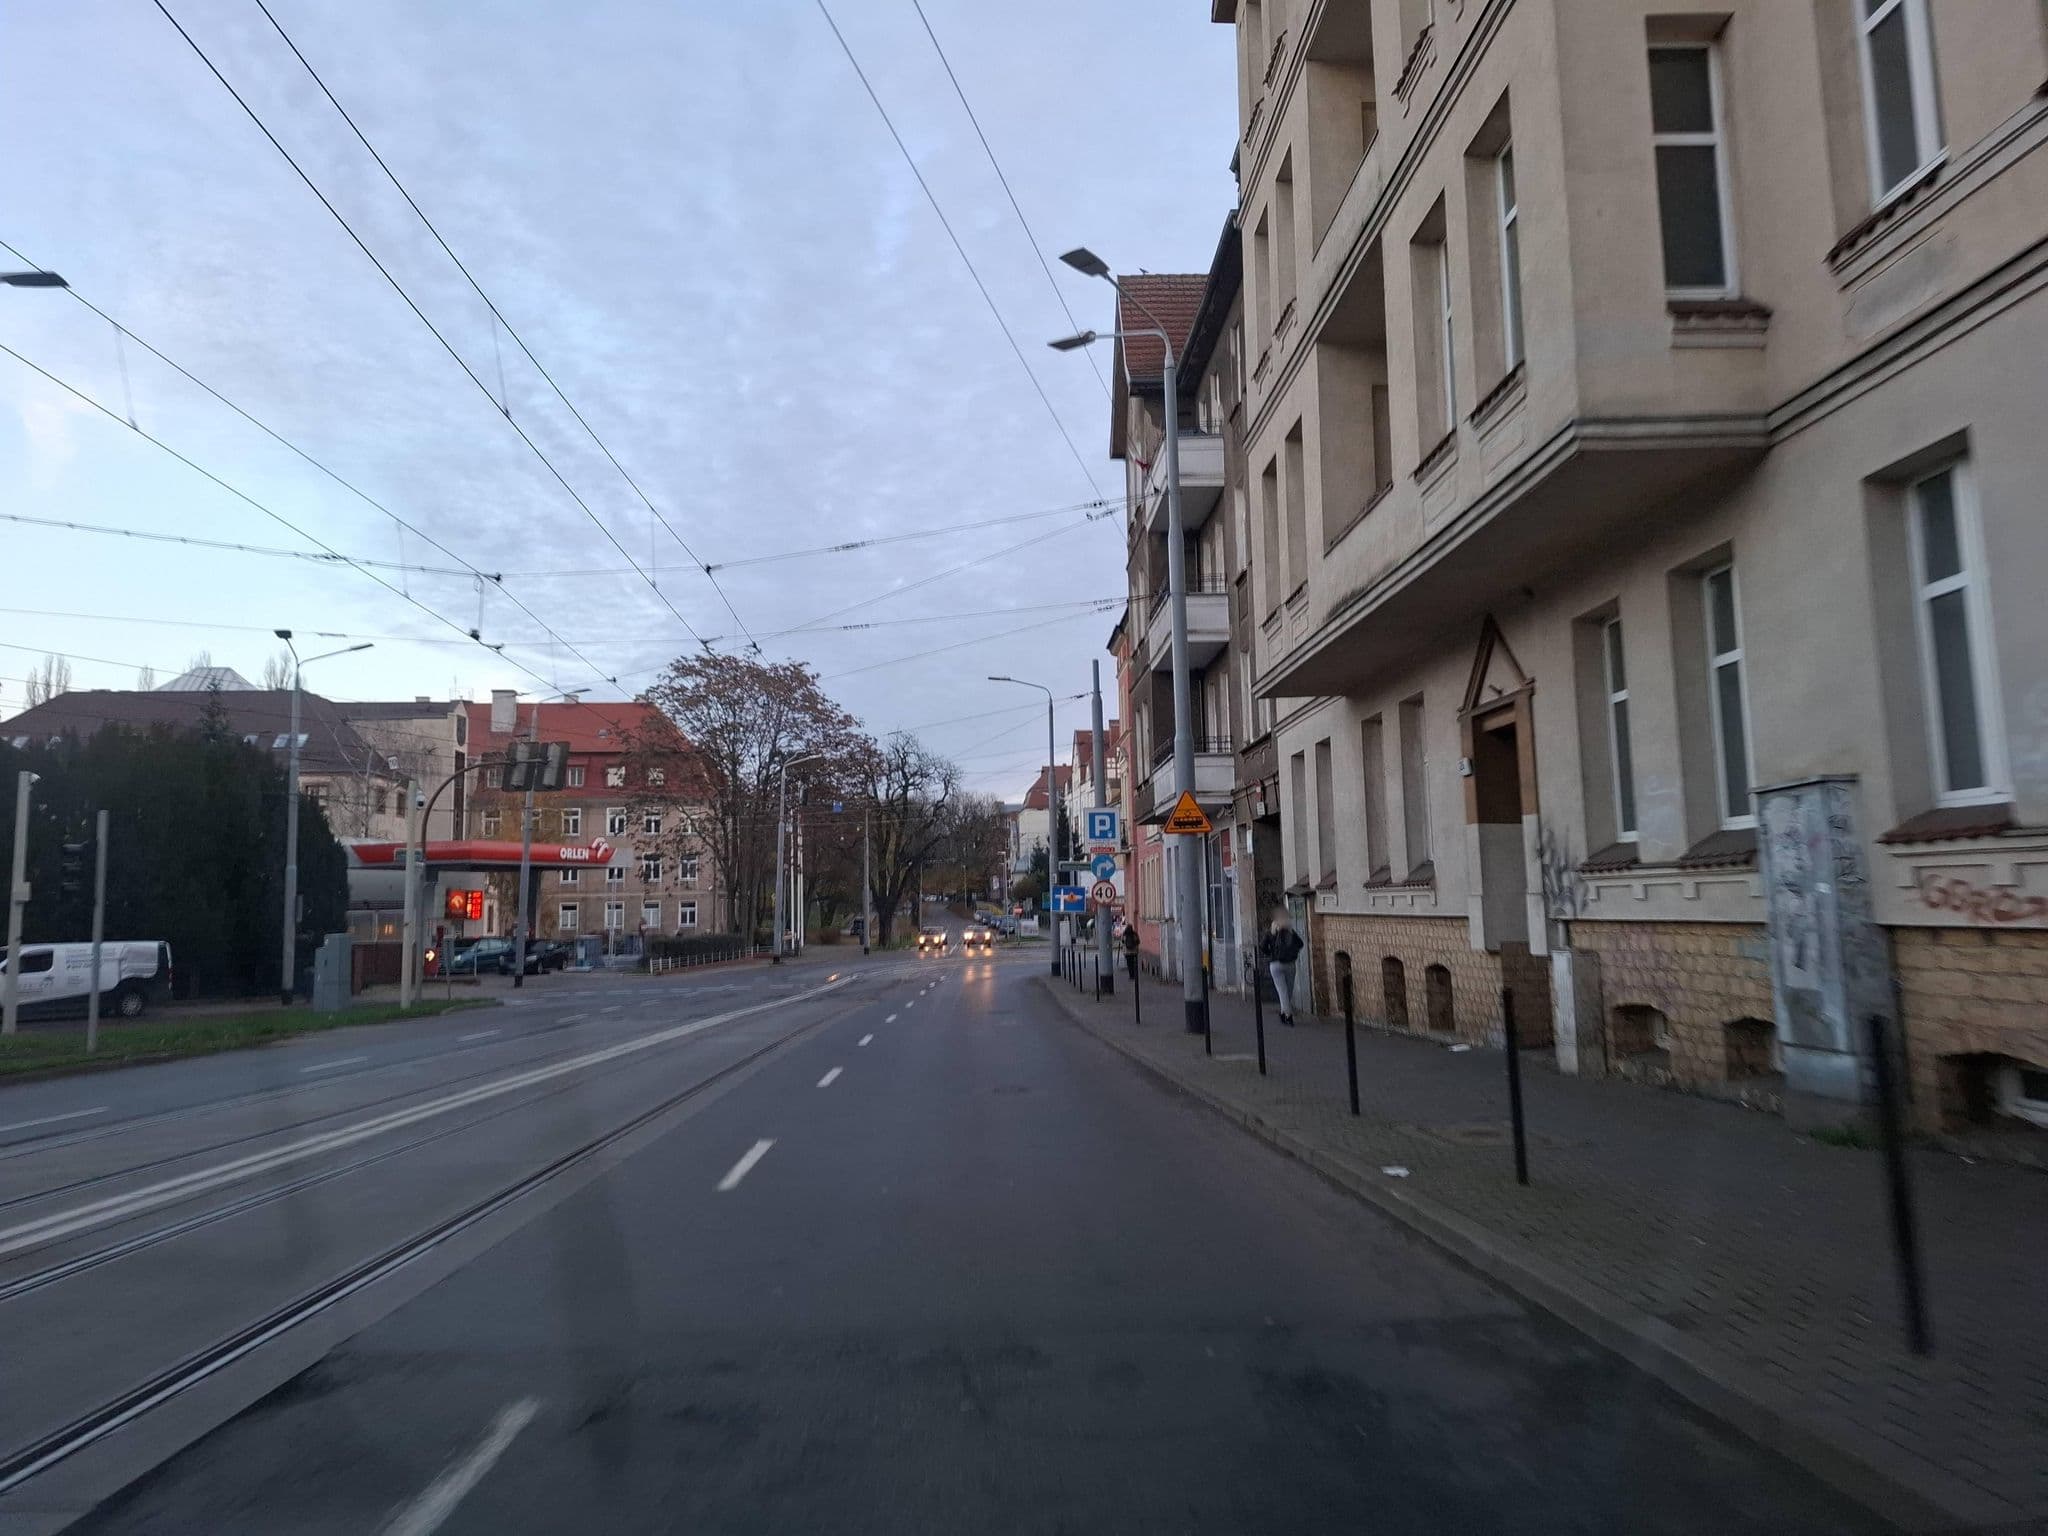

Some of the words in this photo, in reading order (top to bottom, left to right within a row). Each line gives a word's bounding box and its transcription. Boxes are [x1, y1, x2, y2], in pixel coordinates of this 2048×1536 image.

[1095, 815, 1110, 837] P
[560, 847, 590, 860] ORLEN
[1095, 886, 1113, 899] 40
